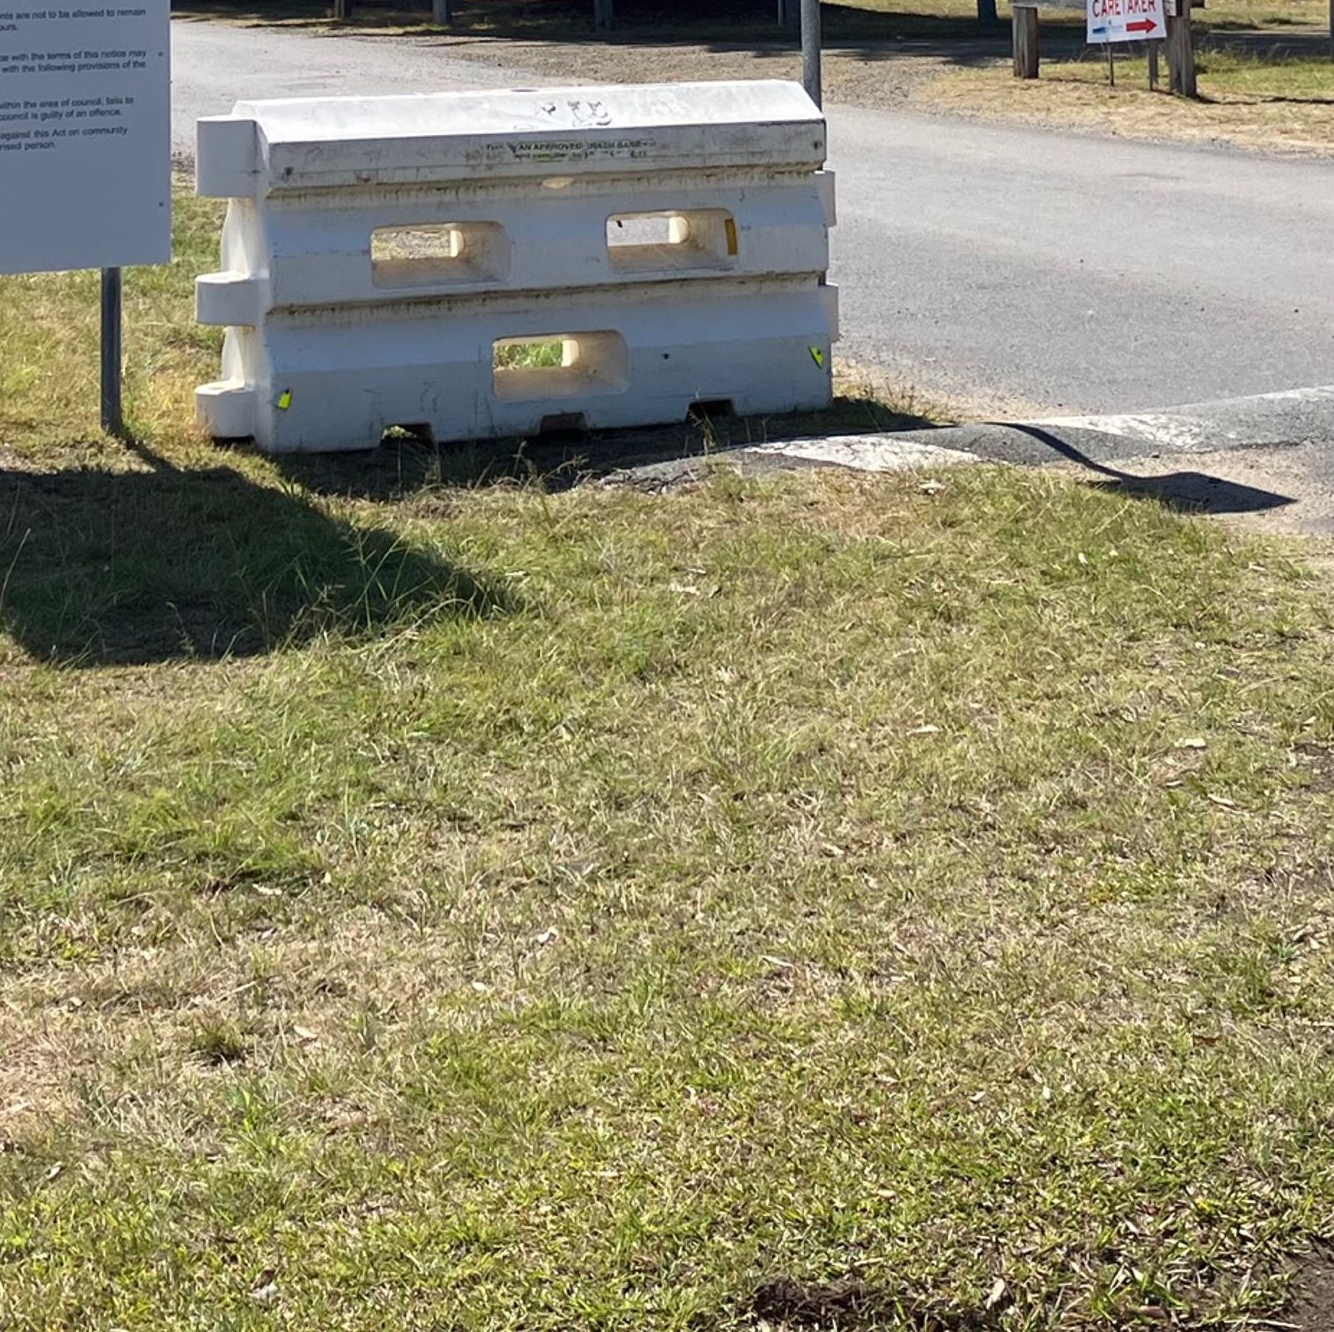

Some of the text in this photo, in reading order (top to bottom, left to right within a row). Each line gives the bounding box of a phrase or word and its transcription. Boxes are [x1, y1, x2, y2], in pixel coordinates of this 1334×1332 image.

[11, 53, 29, 61] with
[31, 52, 45, 60] the
[47, 51, 71, 60] terms
[83, 50, 99, 59] this
[100, 50, 126, 58] notice
[128, 50, 146, 59] may
